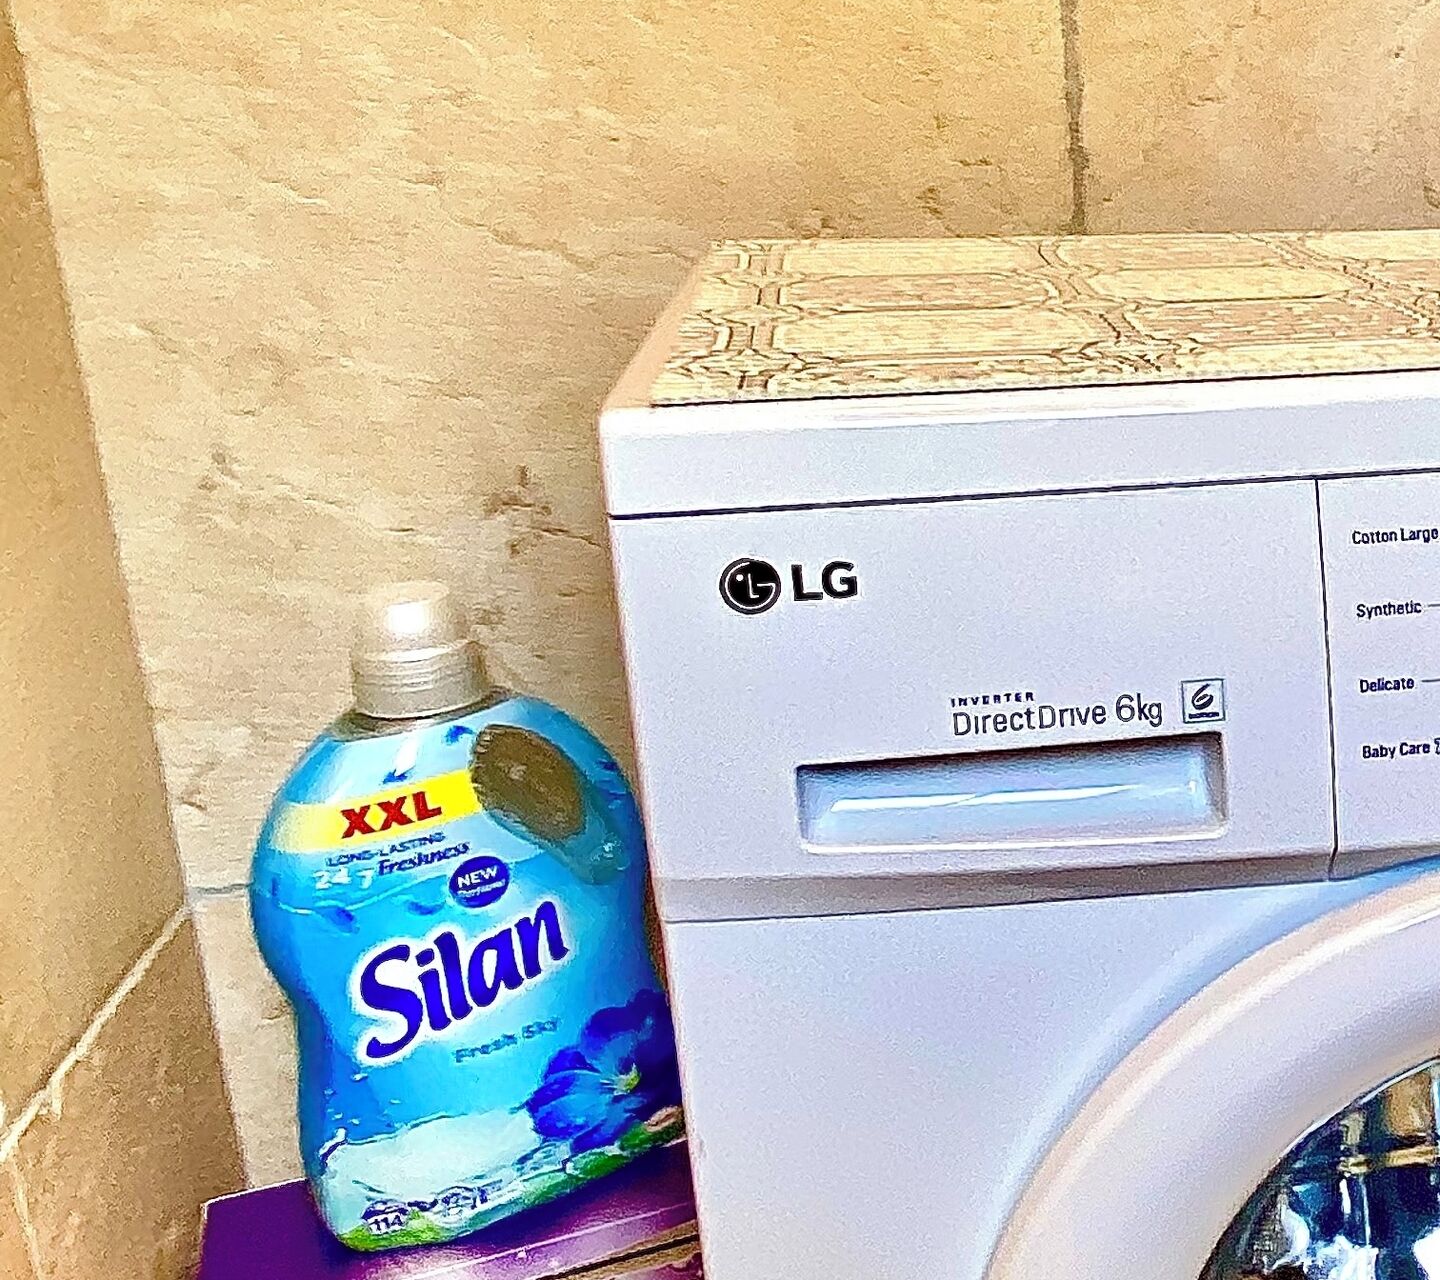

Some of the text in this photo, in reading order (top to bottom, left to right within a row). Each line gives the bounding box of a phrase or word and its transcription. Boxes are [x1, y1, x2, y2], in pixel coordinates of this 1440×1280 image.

[1351, 525, 1440, 546] Cotton Large
[791, 560, 859, 603] LG
[1355, 600, 1423, 620] Synthetic
[1359, 675, 1415, 694] Delicate
[950, 691, 1035, 709] INVERTER
[1115, 692, 1164, 728] 6kg
[1361, 741, 1431, 762] Baby Care
[340, 790, 443, 840] XXL
[325, 831, 446, 867] LONG-LASTING
[456, 865, 499, 889] NEW
[359, 900, 569, 1059] Silan
[455, 1033, 519, 1064] Fresh
